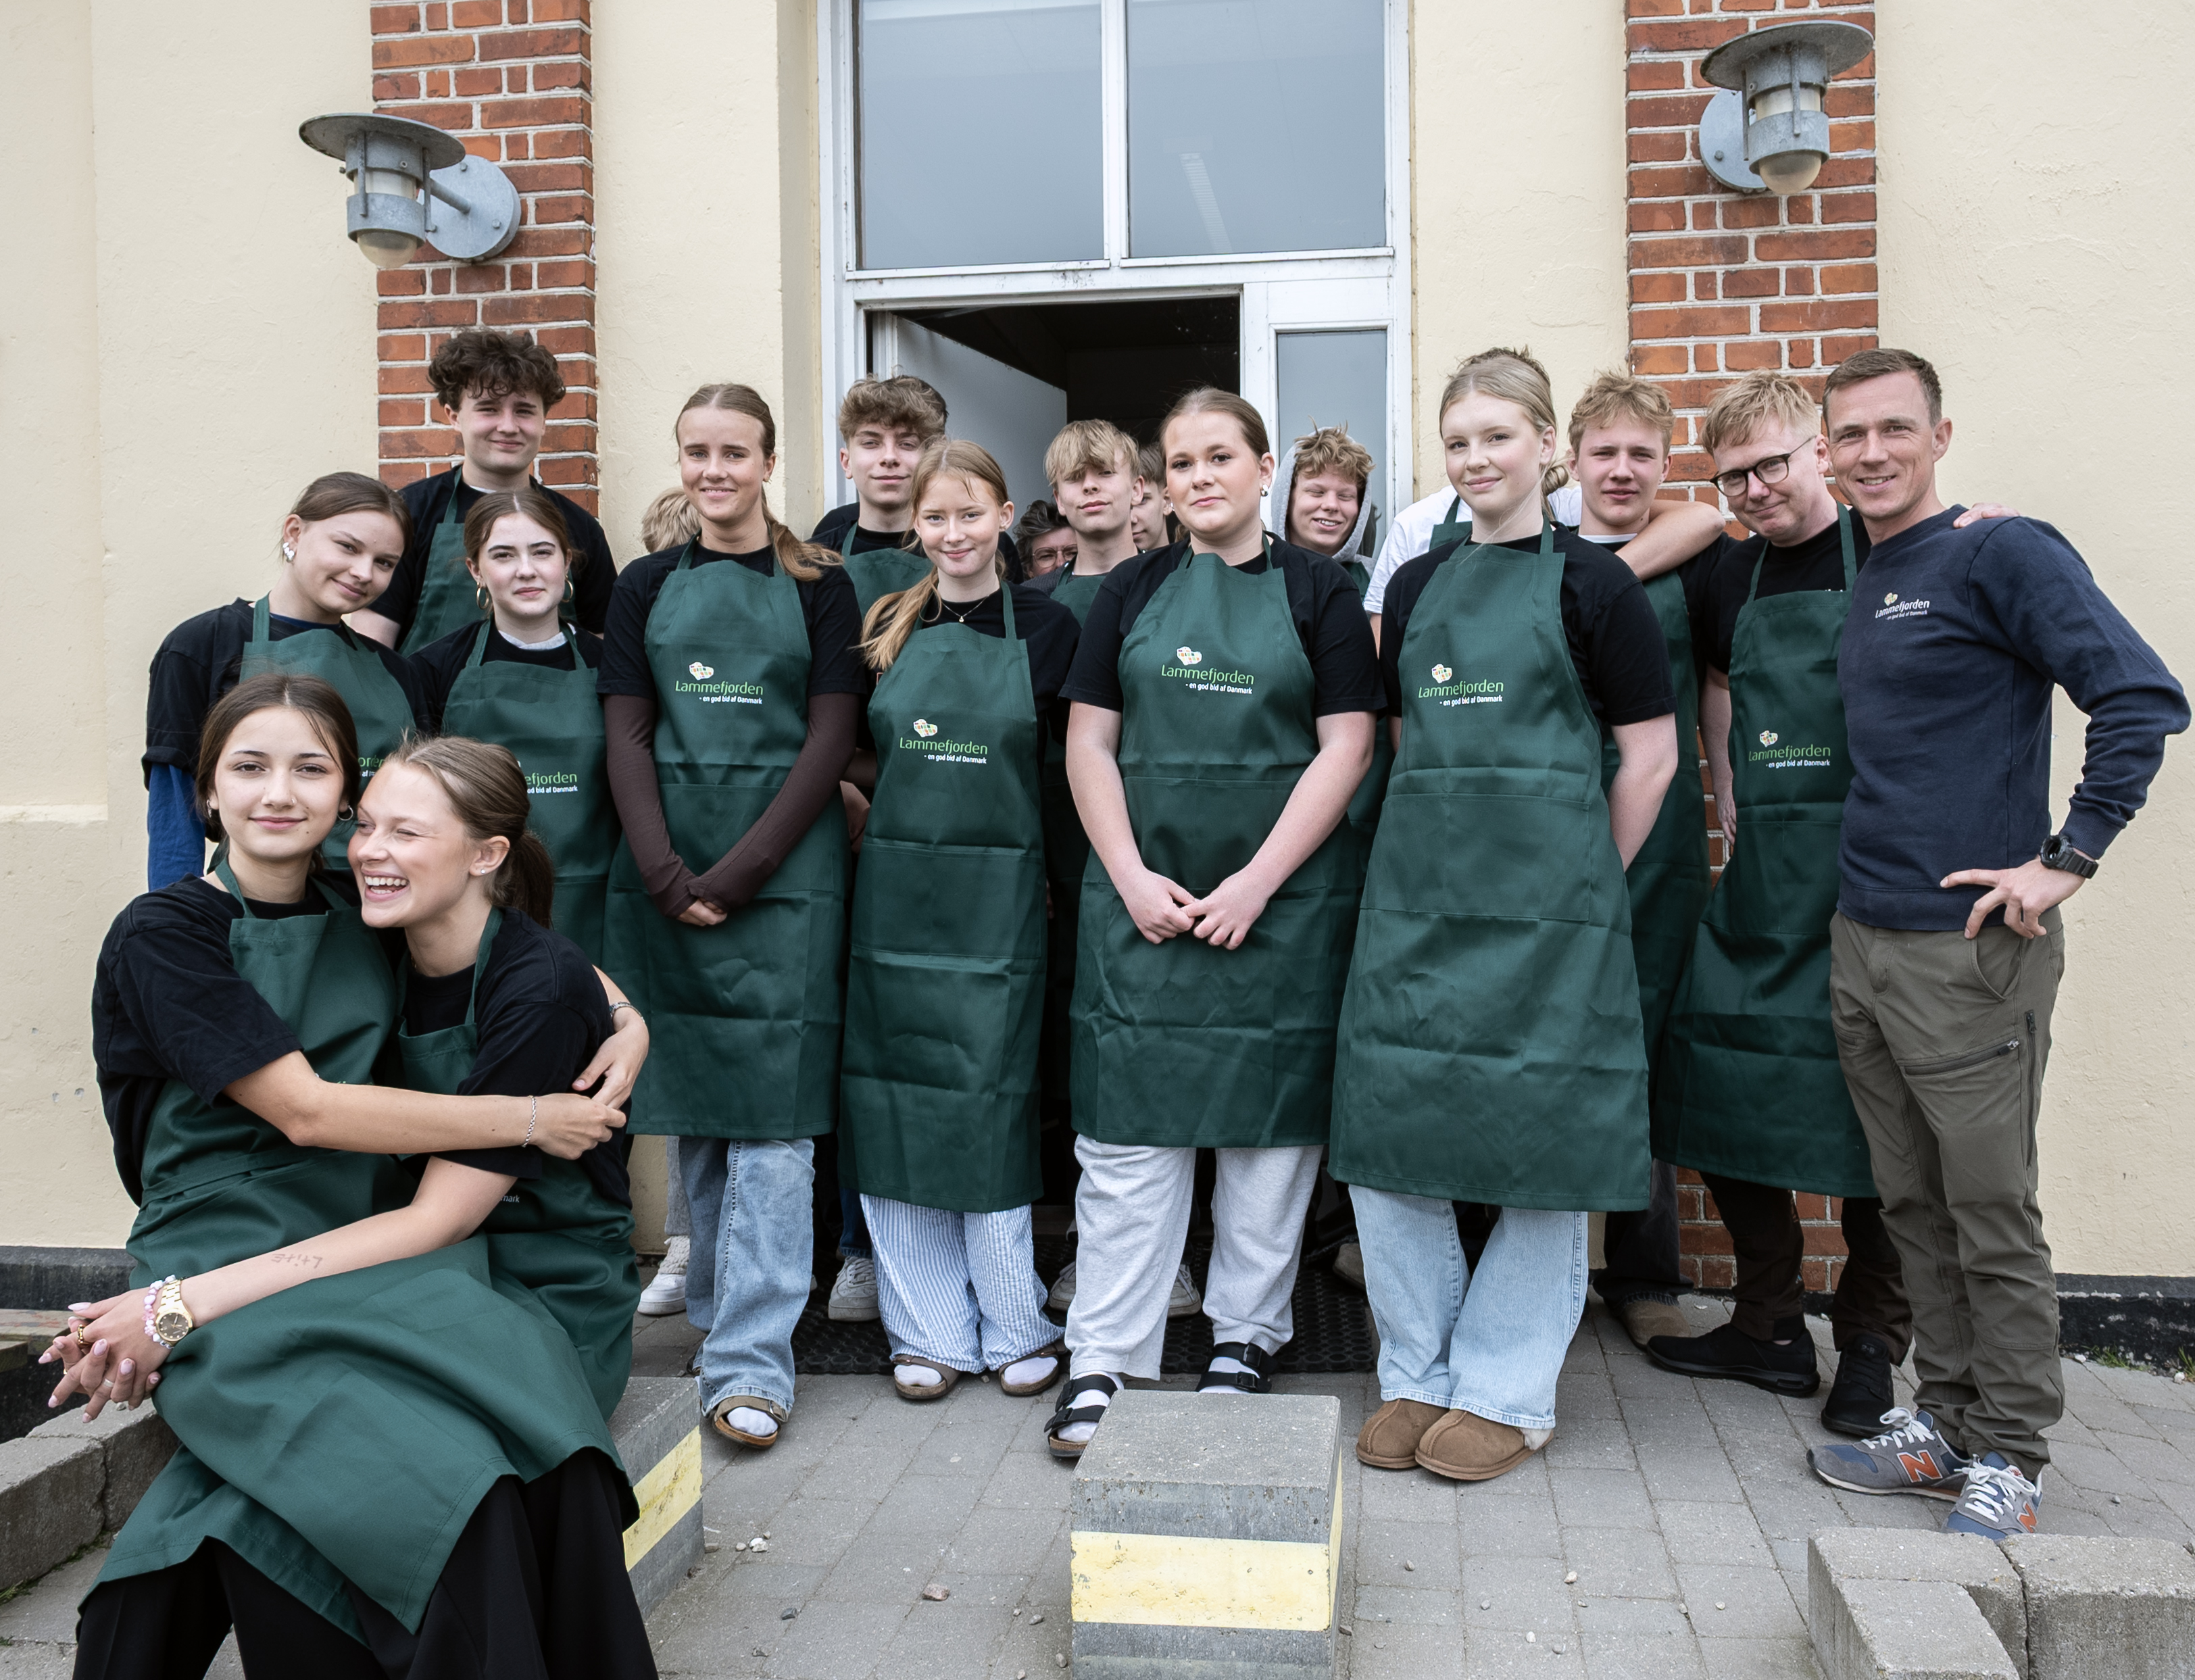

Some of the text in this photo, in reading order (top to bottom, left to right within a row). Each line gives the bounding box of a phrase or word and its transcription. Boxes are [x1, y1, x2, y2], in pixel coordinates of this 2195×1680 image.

[1875, 598, 1930, 618] Lammefjorden
[1161, 664, 1254, 685] Lammefjorden
[675, 681, 764, 696] Lammefjorden
[1198, 683, 1209, 691] god
[1227, 685, 1253, 695] Danmark
[1419, 678, 1504, 698] Lammefjorden
[710, 695, 721, 703] god
[737, 696, 762, 705] Danmark
[1451, 697, 1461, 707] god
[1461, 697, 1470, 705] bid
[1471, 695, 1476, 703] af
[1477, 695, 1503, 703] Danmark
[899, 737, 988, 755] Lammefjorden
[1748, 744, 1831, 762] Lammefjorden
[935, 753, 946, 762] god
[962, 756, 987, 764] Danmark
[1775, 761, 1786, 769] god
[524, 771, 577, 787] efjorden
[526, 786, 535, 794] od
[535, 786, 545, 794] bid
[552, 785, 578, 793] Danmark
[500, 1195, 520, 1203] mark
[1896, 1449, 1944, 1483] N
